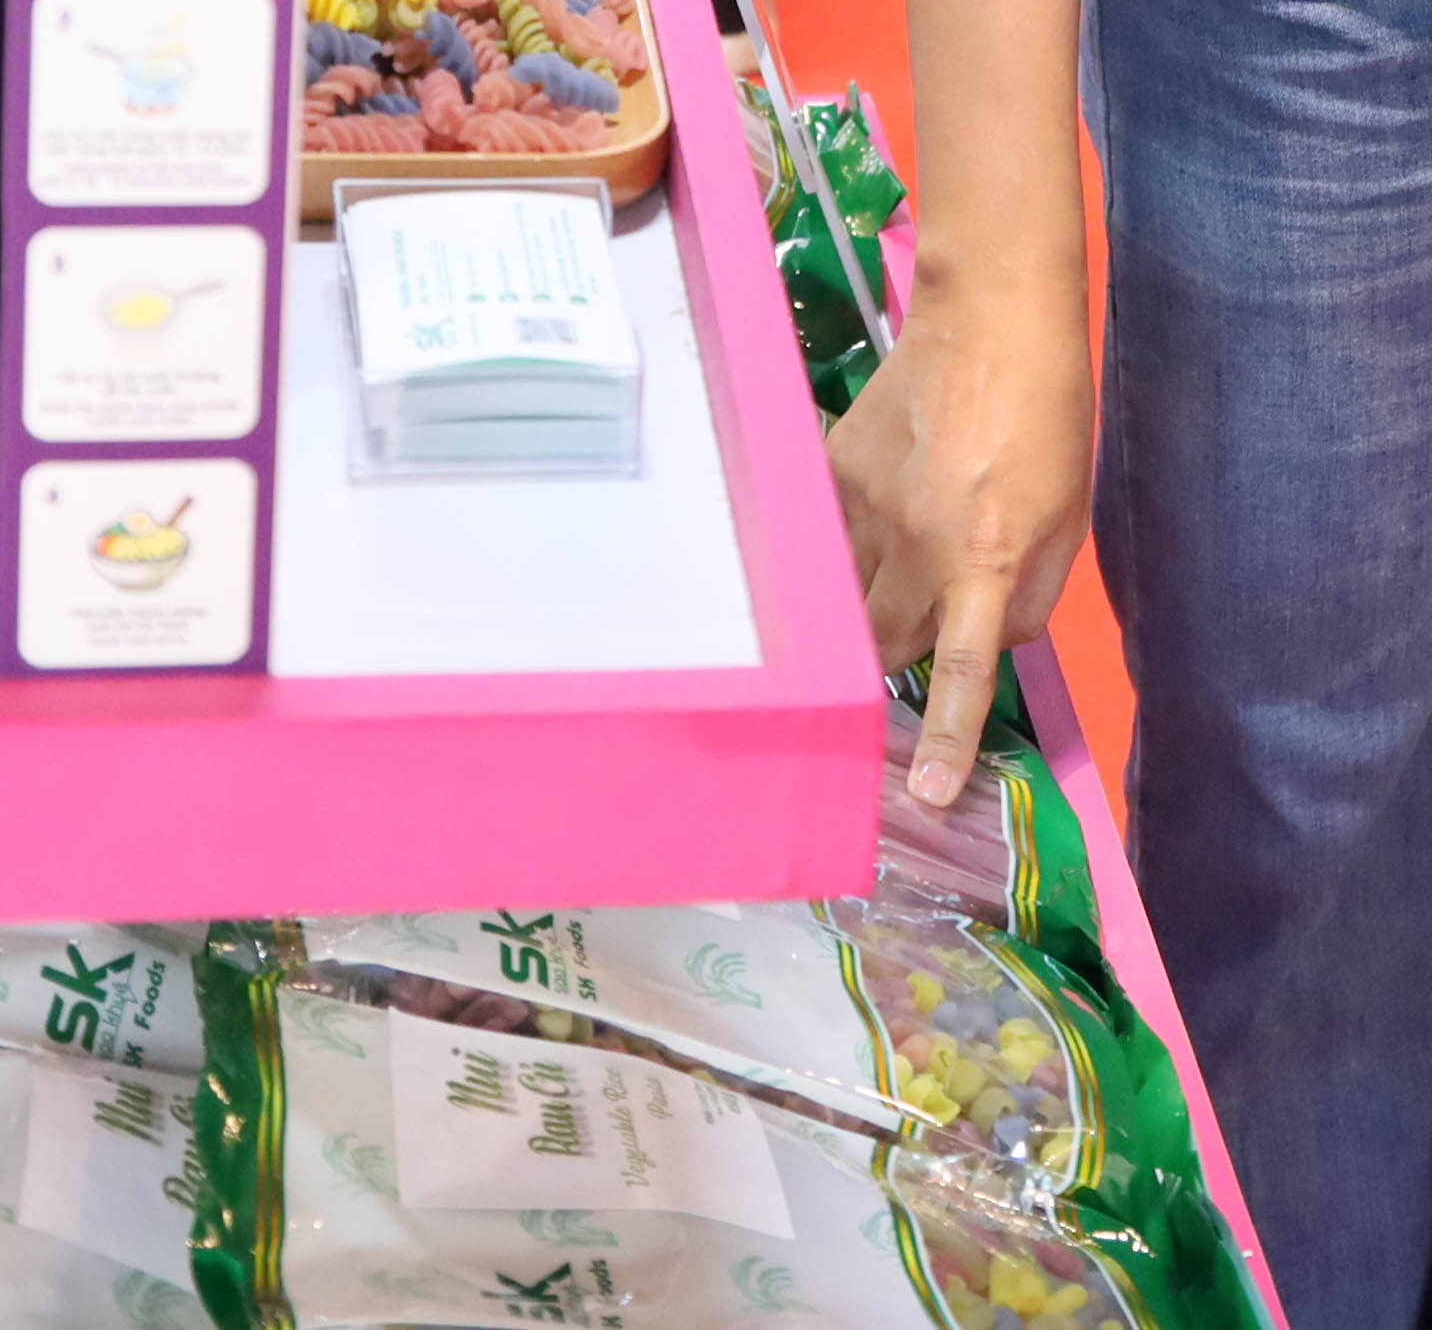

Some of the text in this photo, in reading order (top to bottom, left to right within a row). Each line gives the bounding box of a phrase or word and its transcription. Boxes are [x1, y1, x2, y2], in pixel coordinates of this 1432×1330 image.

[134, 960, 166, 1031] Foods
[445, 1047, 516, 1115] Nui
[607, 1107, 656, 1188] Vegetable
